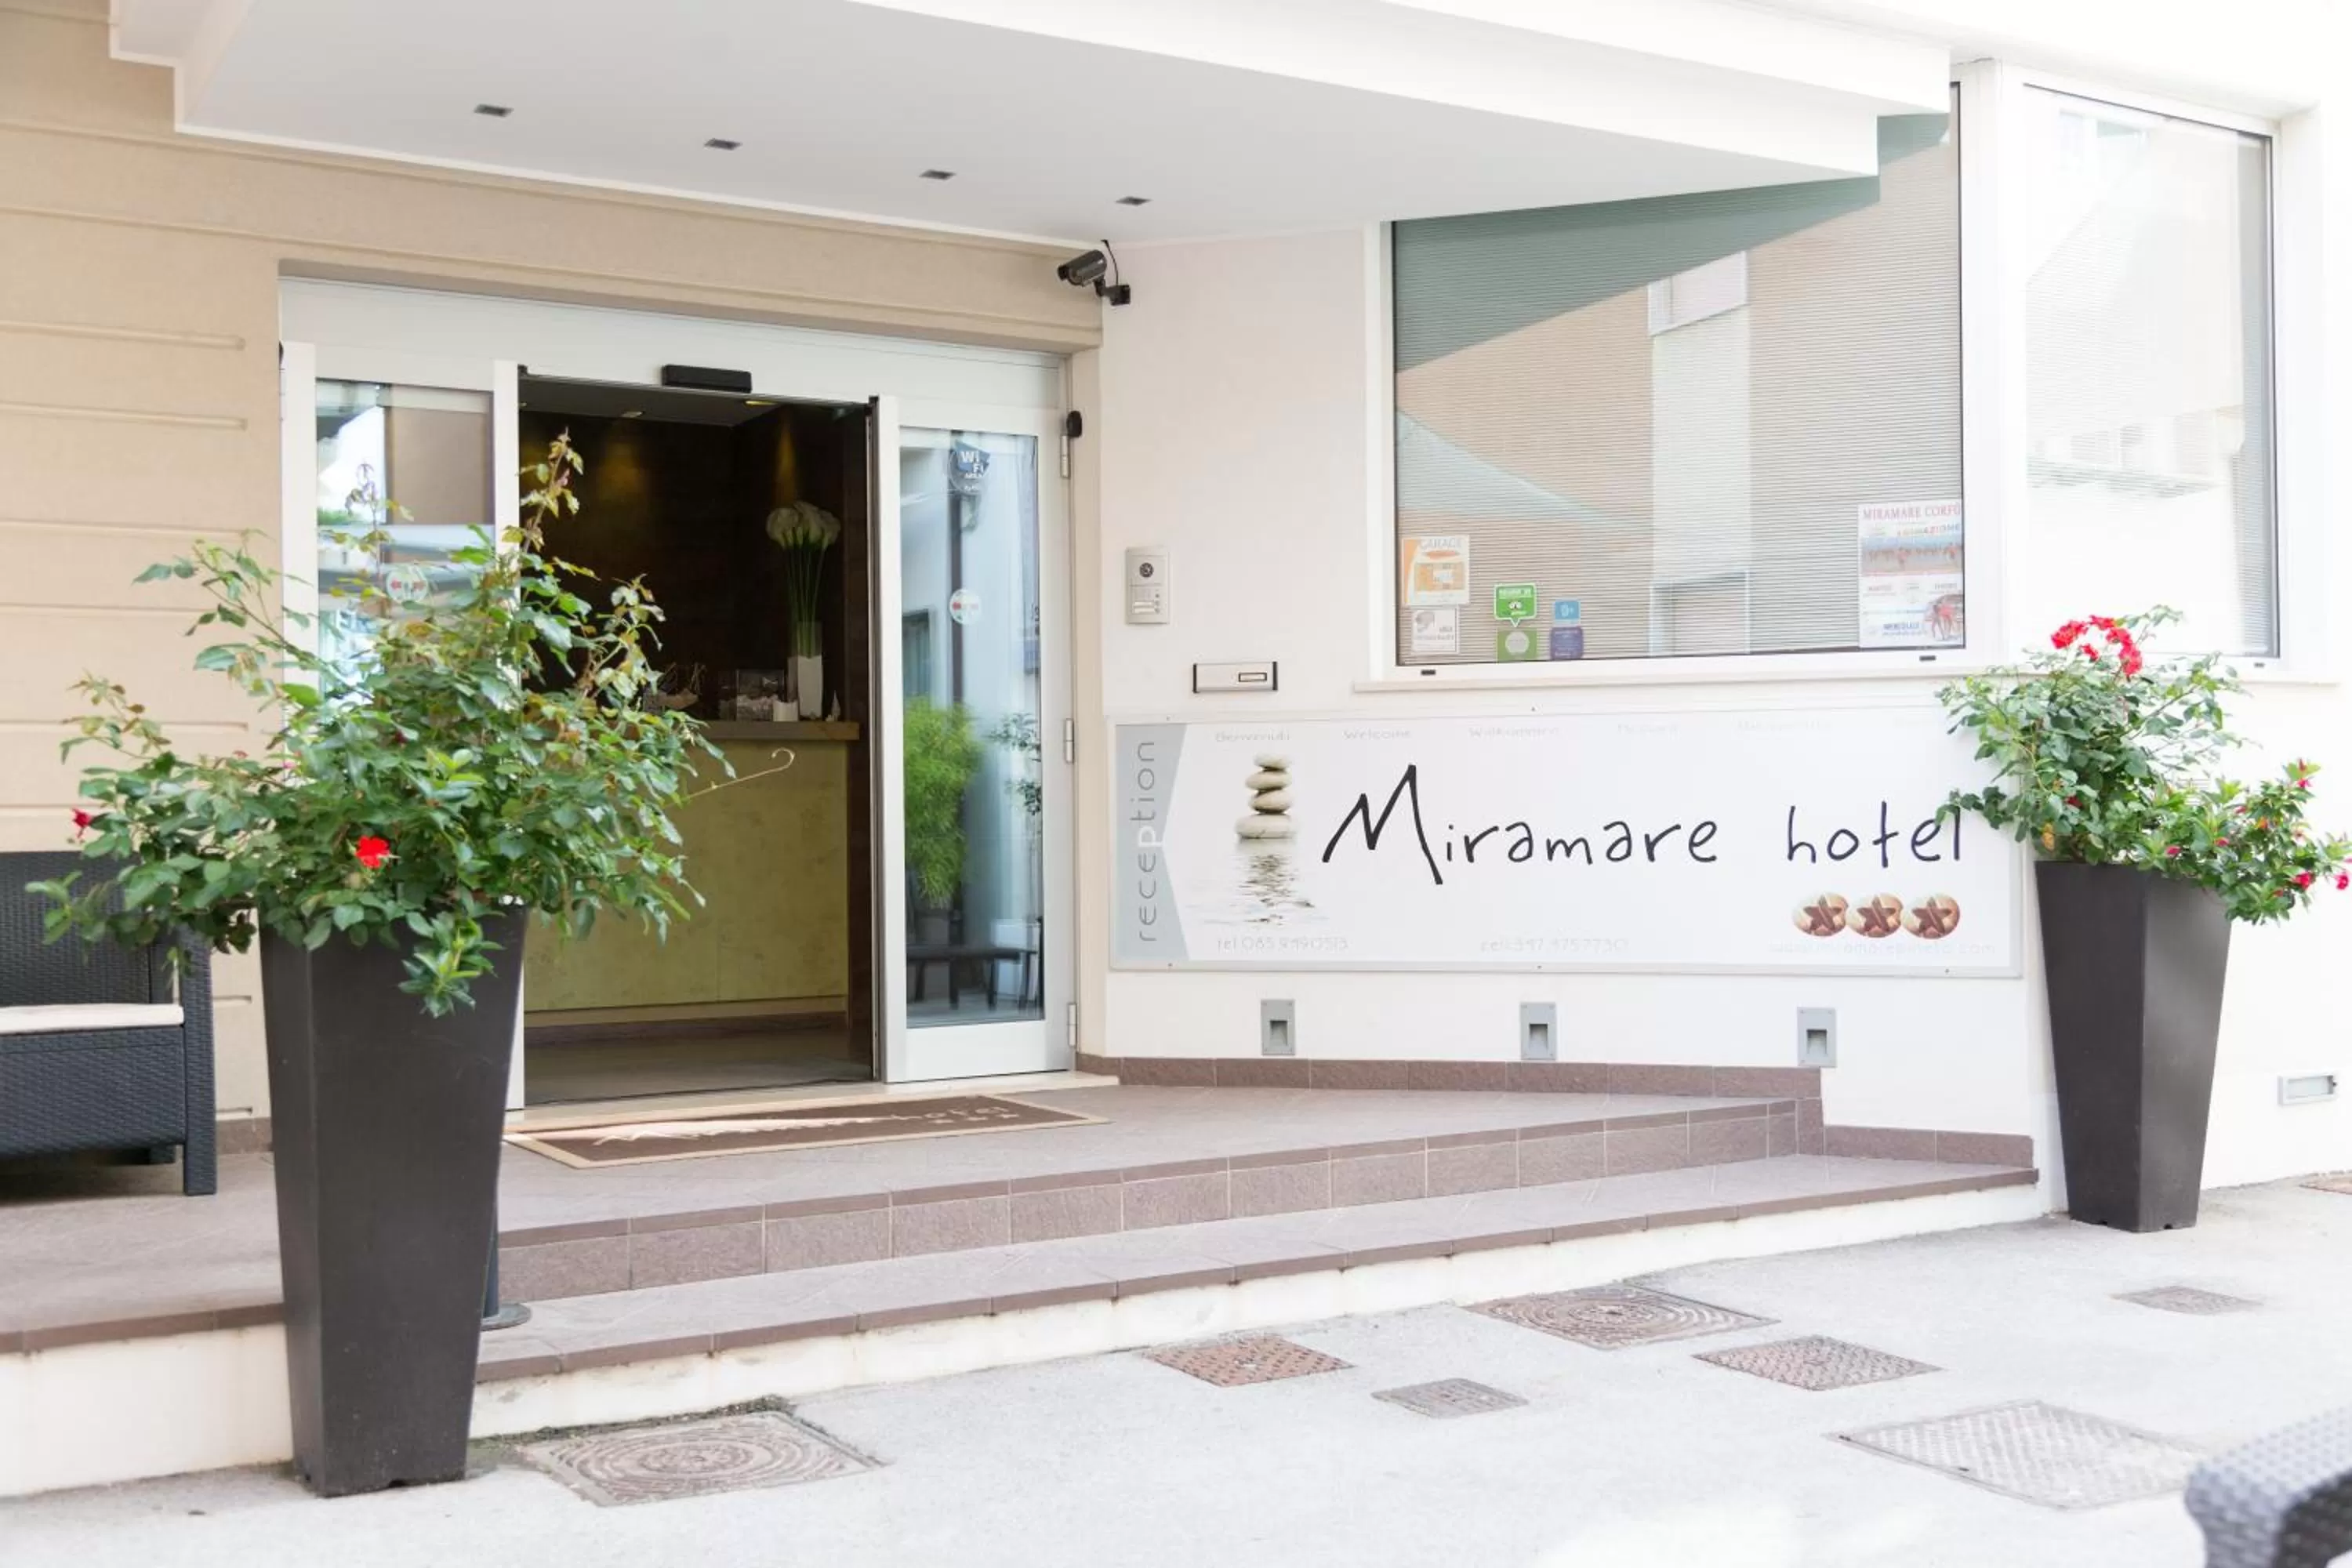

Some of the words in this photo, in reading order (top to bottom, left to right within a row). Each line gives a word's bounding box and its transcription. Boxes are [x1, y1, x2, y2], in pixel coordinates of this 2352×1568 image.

[1863, 506, 1922, 520] MIRAMARE
[1130, 740, 1163, 942] reception
[1322, 764, 1719, 885] Miramare
[1787, 800, 1961, 869] hotel
